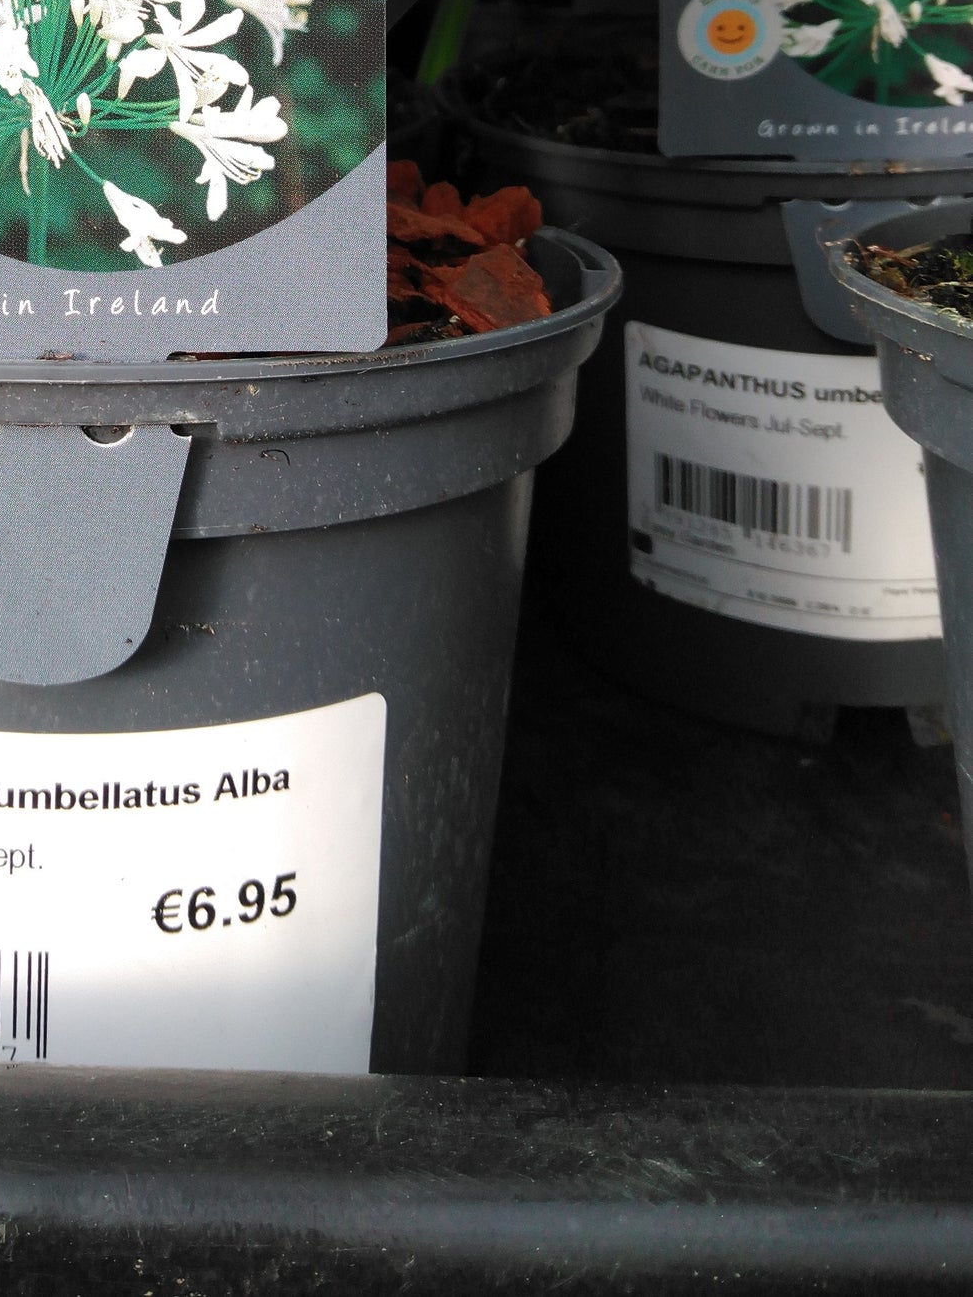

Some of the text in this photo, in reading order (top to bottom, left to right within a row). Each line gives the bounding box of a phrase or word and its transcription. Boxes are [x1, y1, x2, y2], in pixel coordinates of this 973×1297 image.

[757, 117, 840, 138] Grown
[894, 115, 973, 136] Irela
[2, 293, 35, 316] in
[63, 289, 220, 317] Ireland
[638, 352, 806, 401] AGAPANTHUS
[213, 767, 291, 801] Alba
[151, 871, 298, 934] €6.95
